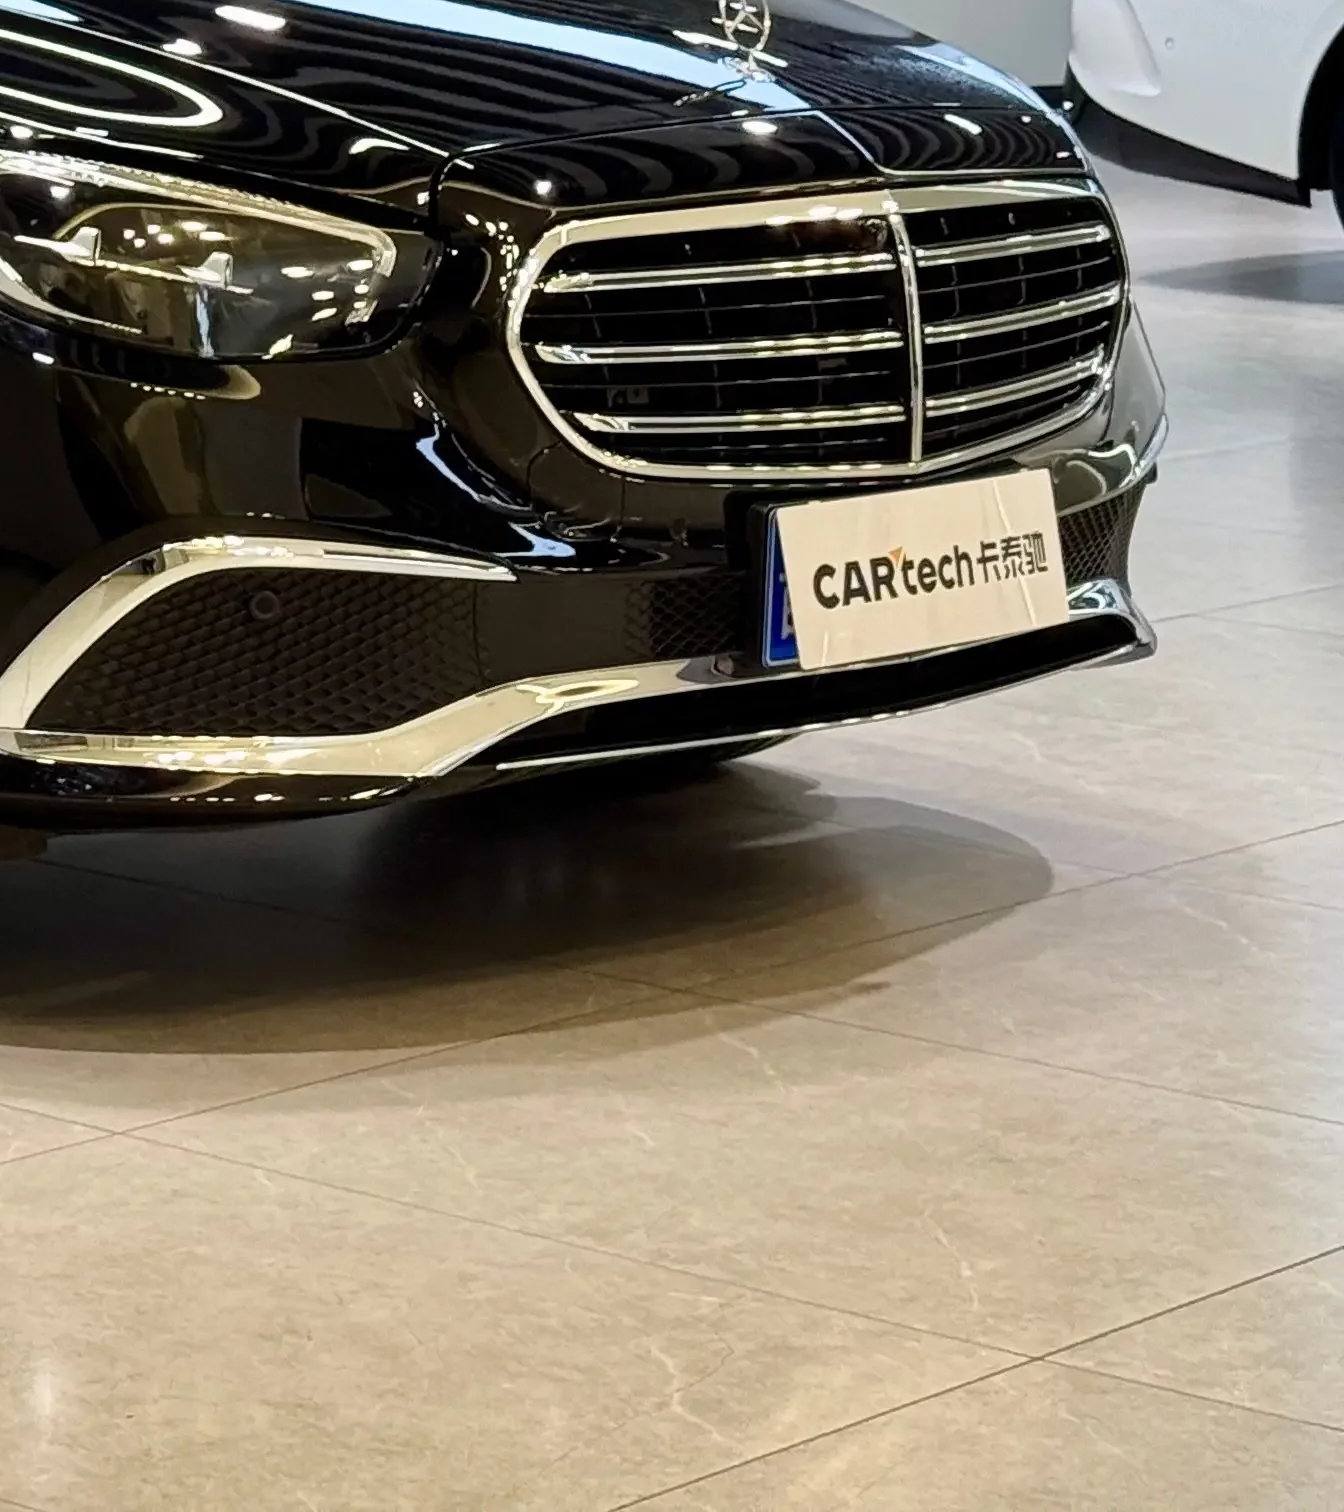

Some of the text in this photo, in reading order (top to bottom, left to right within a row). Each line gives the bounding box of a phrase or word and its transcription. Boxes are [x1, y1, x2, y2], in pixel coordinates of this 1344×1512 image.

[813, 545, 975, 610] CARtech
[976, 531, 1049, 584] 卡泰驰
